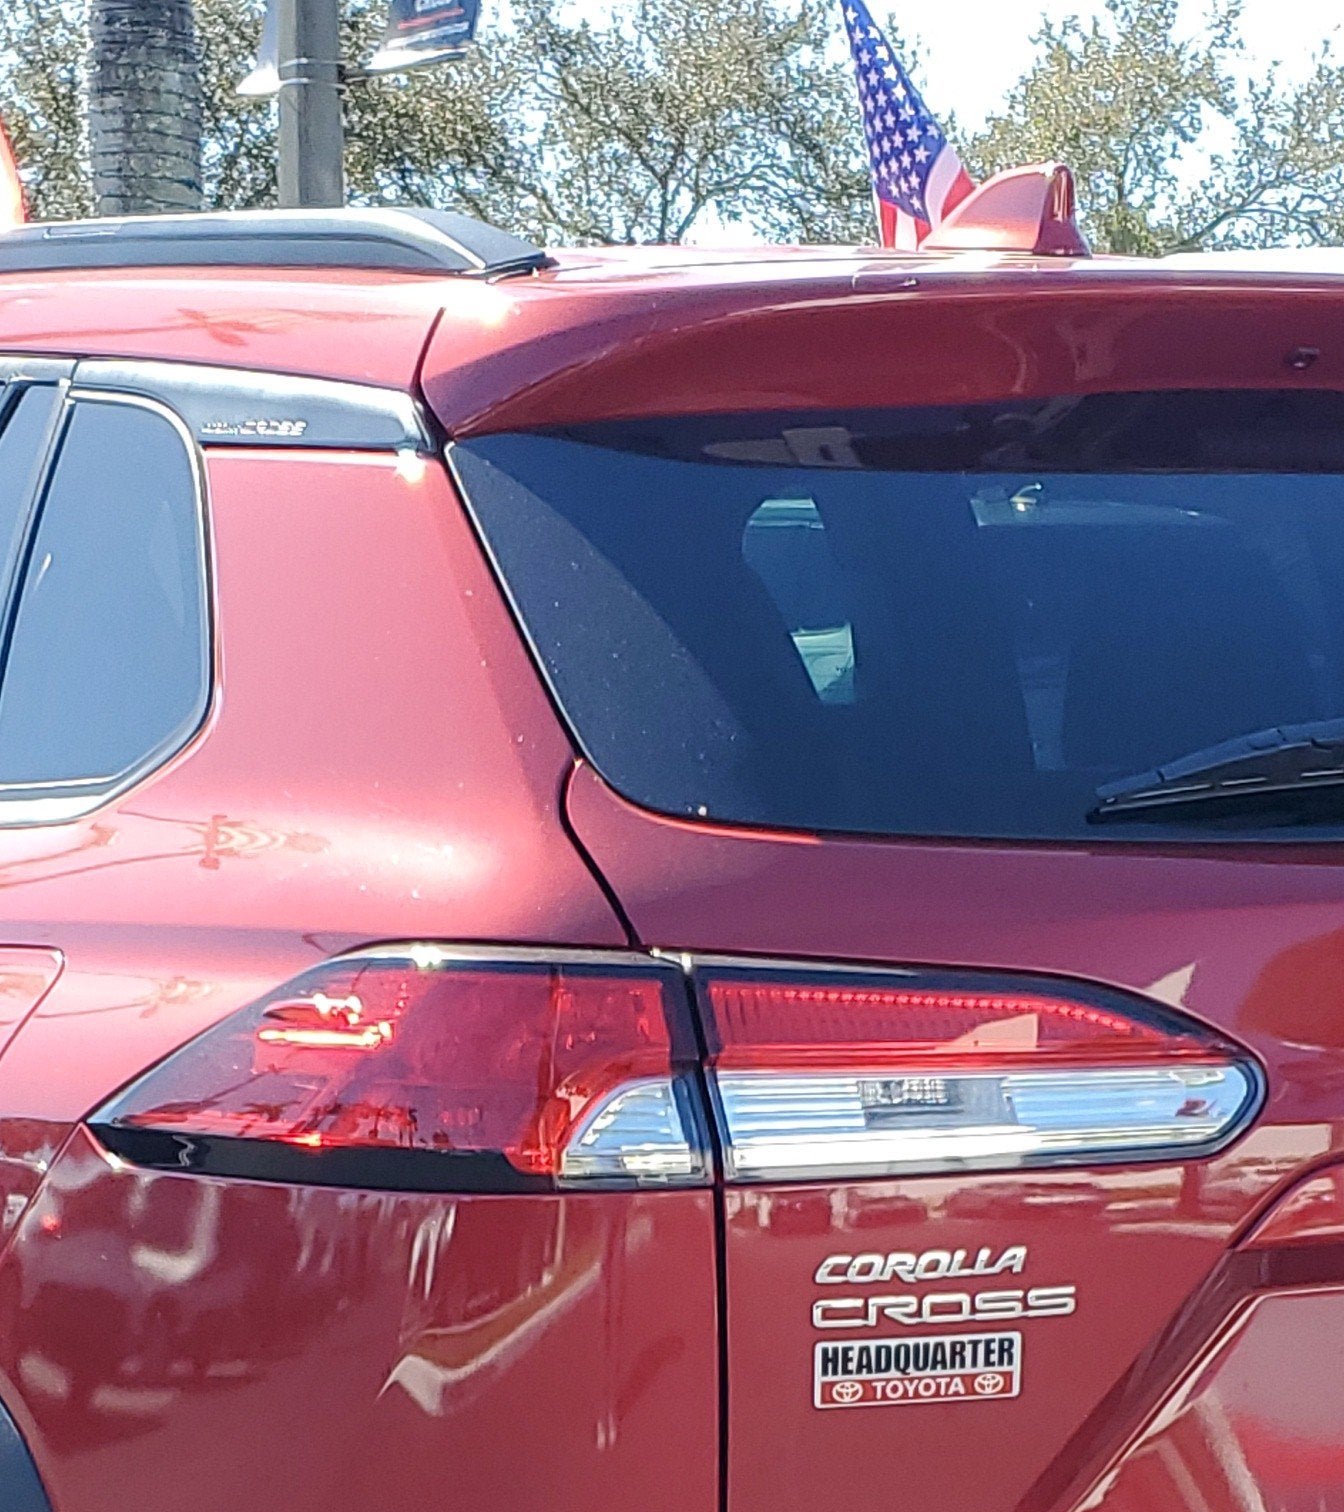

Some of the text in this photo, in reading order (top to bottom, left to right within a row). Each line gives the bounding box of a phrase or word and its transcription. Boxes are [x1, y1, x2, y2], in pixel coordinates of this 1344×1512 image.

[815, 1246, 1027, 1284] COROLLA
[812, 1285, 1077, 1328] CROSS
[821, 1337, 1015, 1378] HEADQUARTER
[871, 1377, 965, 1400] TOYOTA
